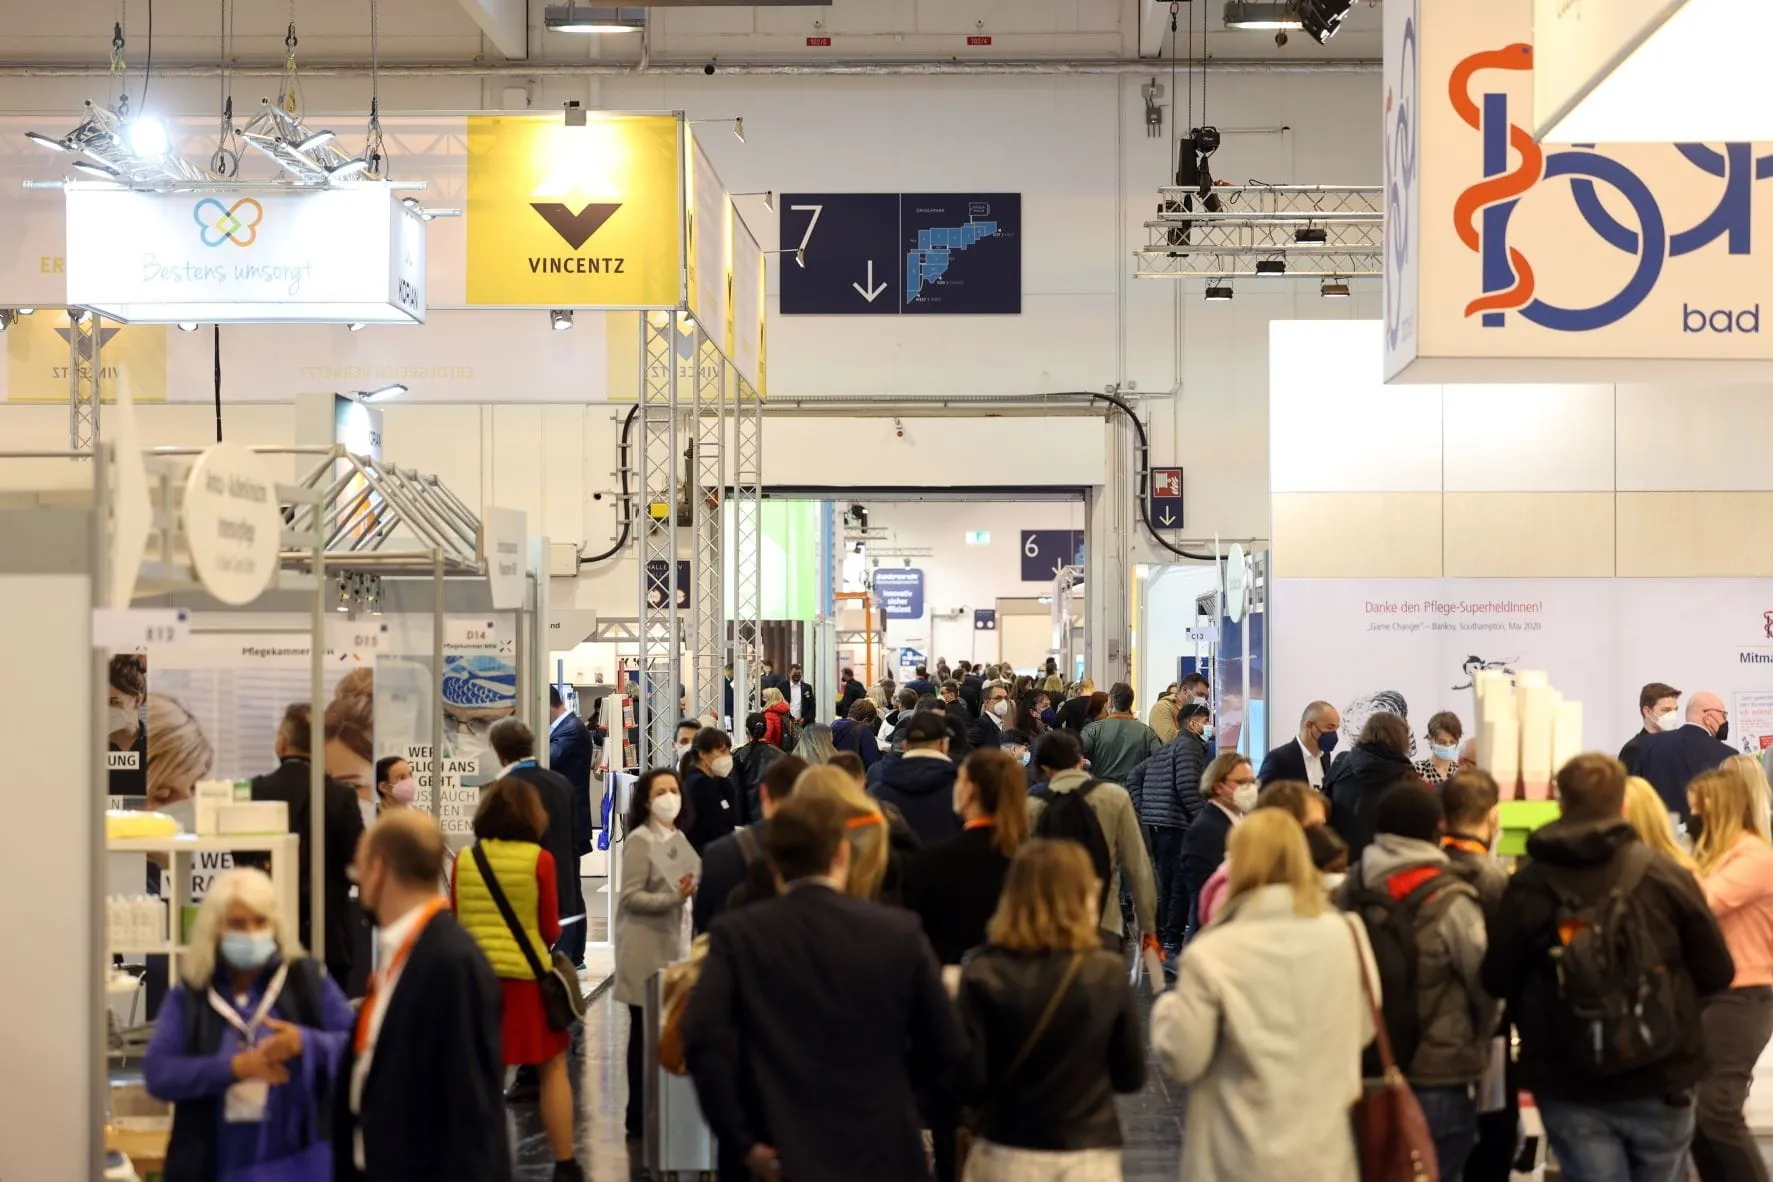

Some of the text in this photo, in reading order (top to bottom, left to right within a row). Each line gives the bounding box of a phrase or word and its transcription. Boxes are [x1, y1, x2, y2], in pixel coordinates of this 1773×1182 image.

[528, 257, 624, 274] VINCENTZ
[142, 253, 313, 296] Bestens umsorgt
[1683, 303, 1759, 333] bad
[1025, 534, 1038, 558] 6
[1365, 601, 1397, 613] Danke
[1401, 601, 1420, 613] den
[1524, 621, 1542, 631] 2020
[466, 631, 486, 640] D14
[242, 647, 310, 658] Pflegekammer
[448, 761, 475, 773] ANS
[440, 790, 475, 802] AUCH
